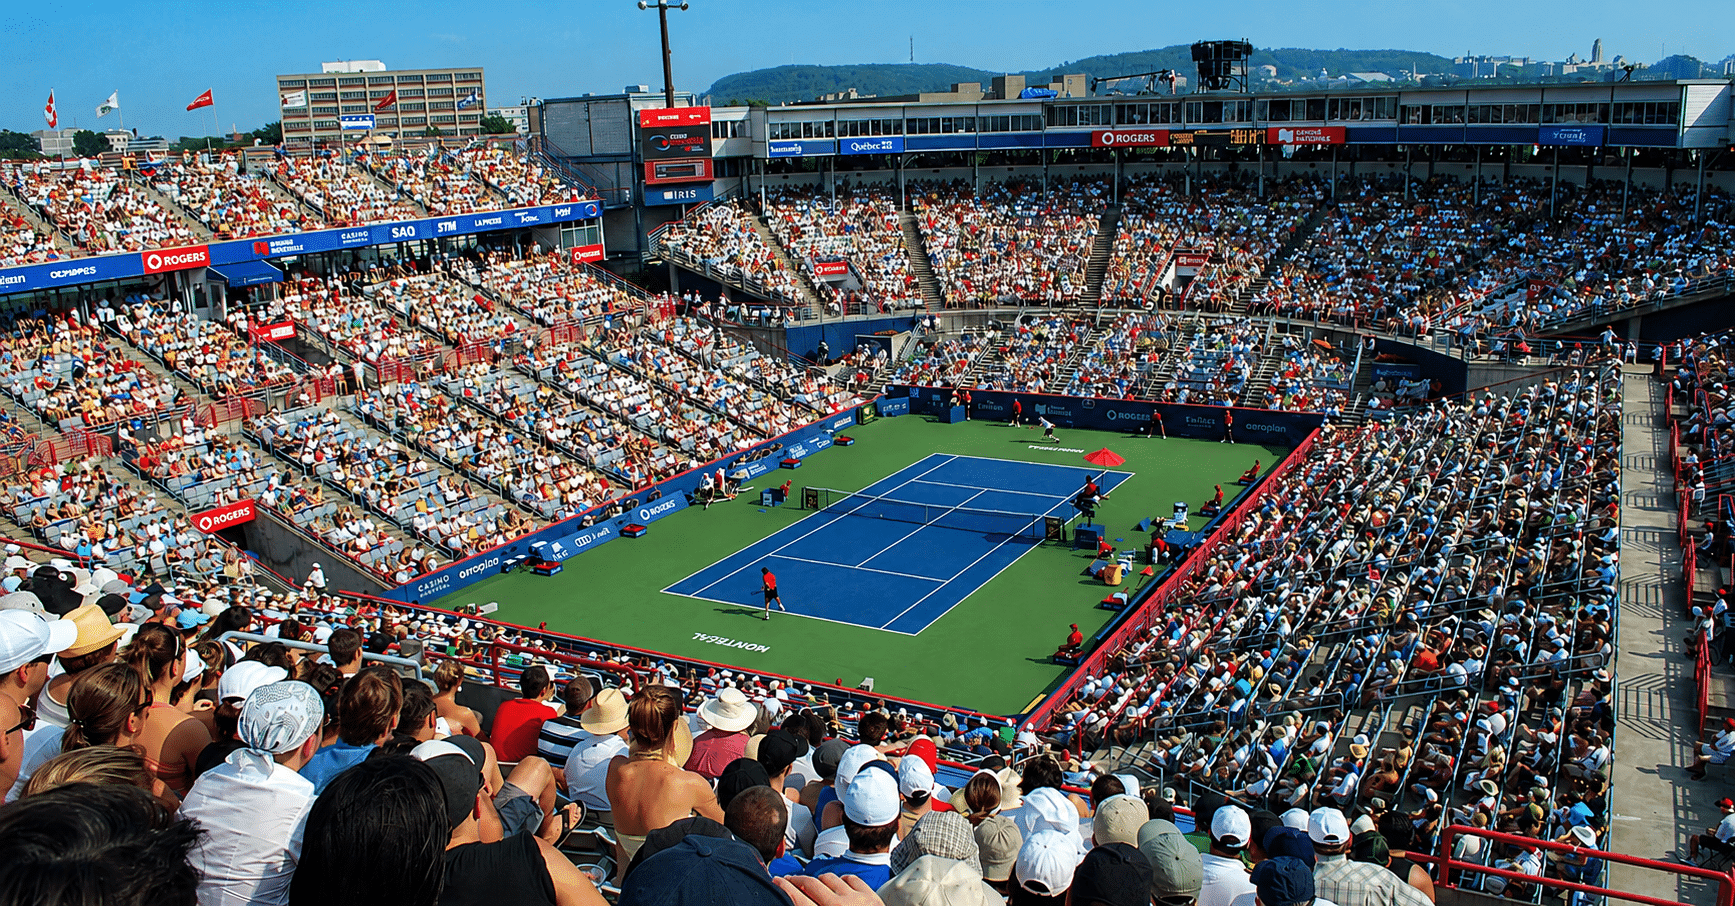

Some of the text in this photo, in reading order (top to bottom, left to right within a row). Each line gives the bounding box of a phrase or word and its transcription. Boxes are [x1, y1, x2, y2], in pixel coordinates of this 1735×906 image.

[1116, 134, 1155, 143] ROGERS
[850, 142, 881, 152] Québec
[674, 189, 697, 200] IRIS
[437, 220, 457, 233] STM
[164, 251, 206, 266] ROGERS
[1245, 423, 1287, 433] aeroplan
[213, 507, 250, 525] ROGERS
